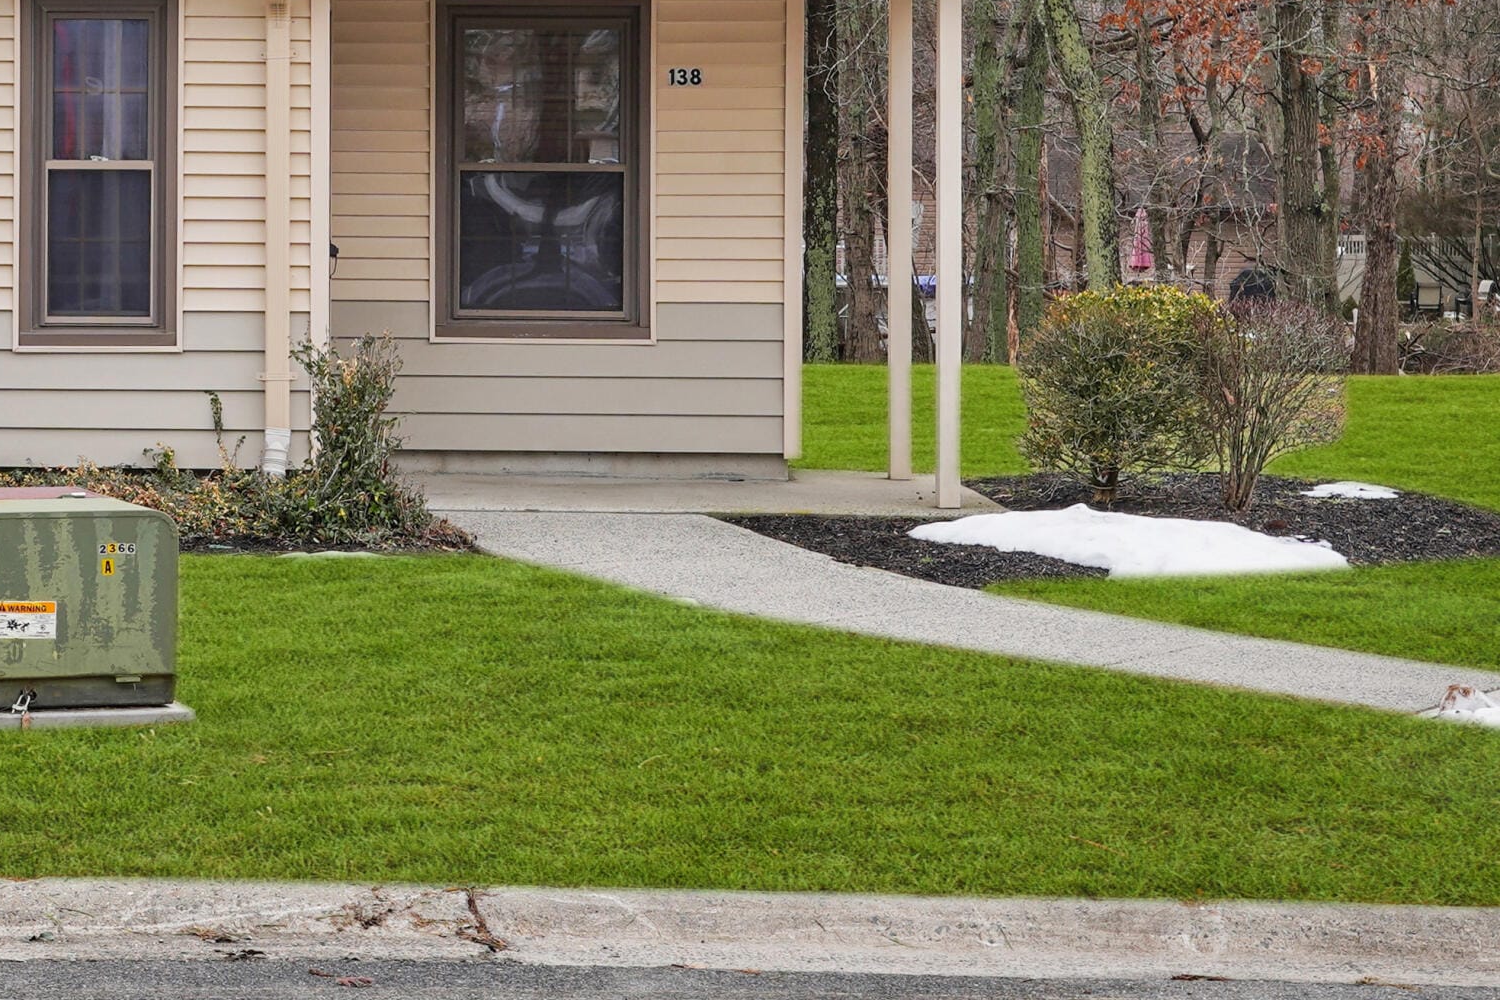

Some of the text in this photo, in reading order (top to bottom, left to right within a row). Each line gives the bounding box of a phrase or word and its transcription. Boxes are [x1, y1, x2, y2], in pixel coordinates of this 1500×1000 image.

[668, 68, 702, 86] 138
[99, 543, 136, 554] 2366
[104, 560, 112, 574] A
[7, 604, 47, 613] WARNING
